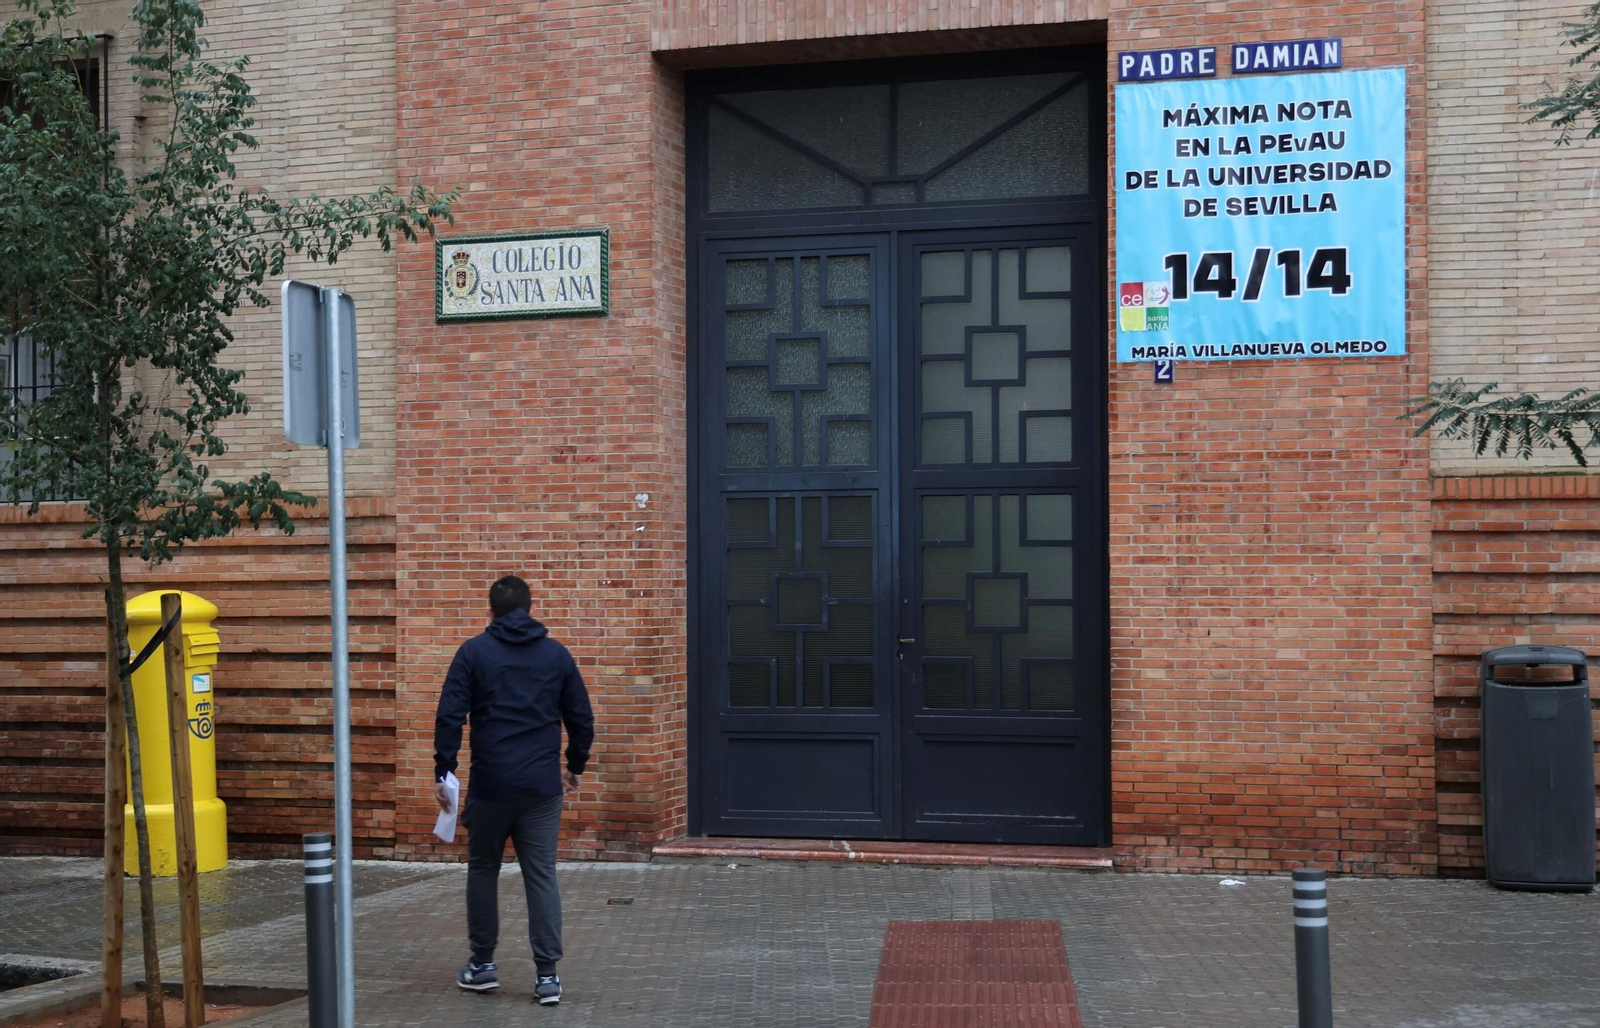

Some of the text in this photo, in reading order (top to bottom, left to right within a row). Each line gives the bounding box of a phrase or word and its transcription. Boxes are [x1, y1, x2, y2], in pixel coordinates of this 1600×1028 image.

[1122, 41, 1338, 77] PADRE DAMIAN
[1163, 100, 1353, 127] MÁXIMA NOTA
[1175, 131, 1346, 157] EN LA PEvAU
[1125, 159, 1392, 190] DE LA UNIVERSIDAD
[1184, 193, 1337, 217] DE SEVILLA
[1164, 248, 1352, 300] 14/14
[480, 275, 595, 305] SANTA ANA
[1121, 294, 1143, 306] ce
[1146, 322, 1169, 331] ANA
[1131, 340, 1388, 358] MARÍA VILLANUEVA OLMEDO
[1157, 360, 1170, 379] 2
